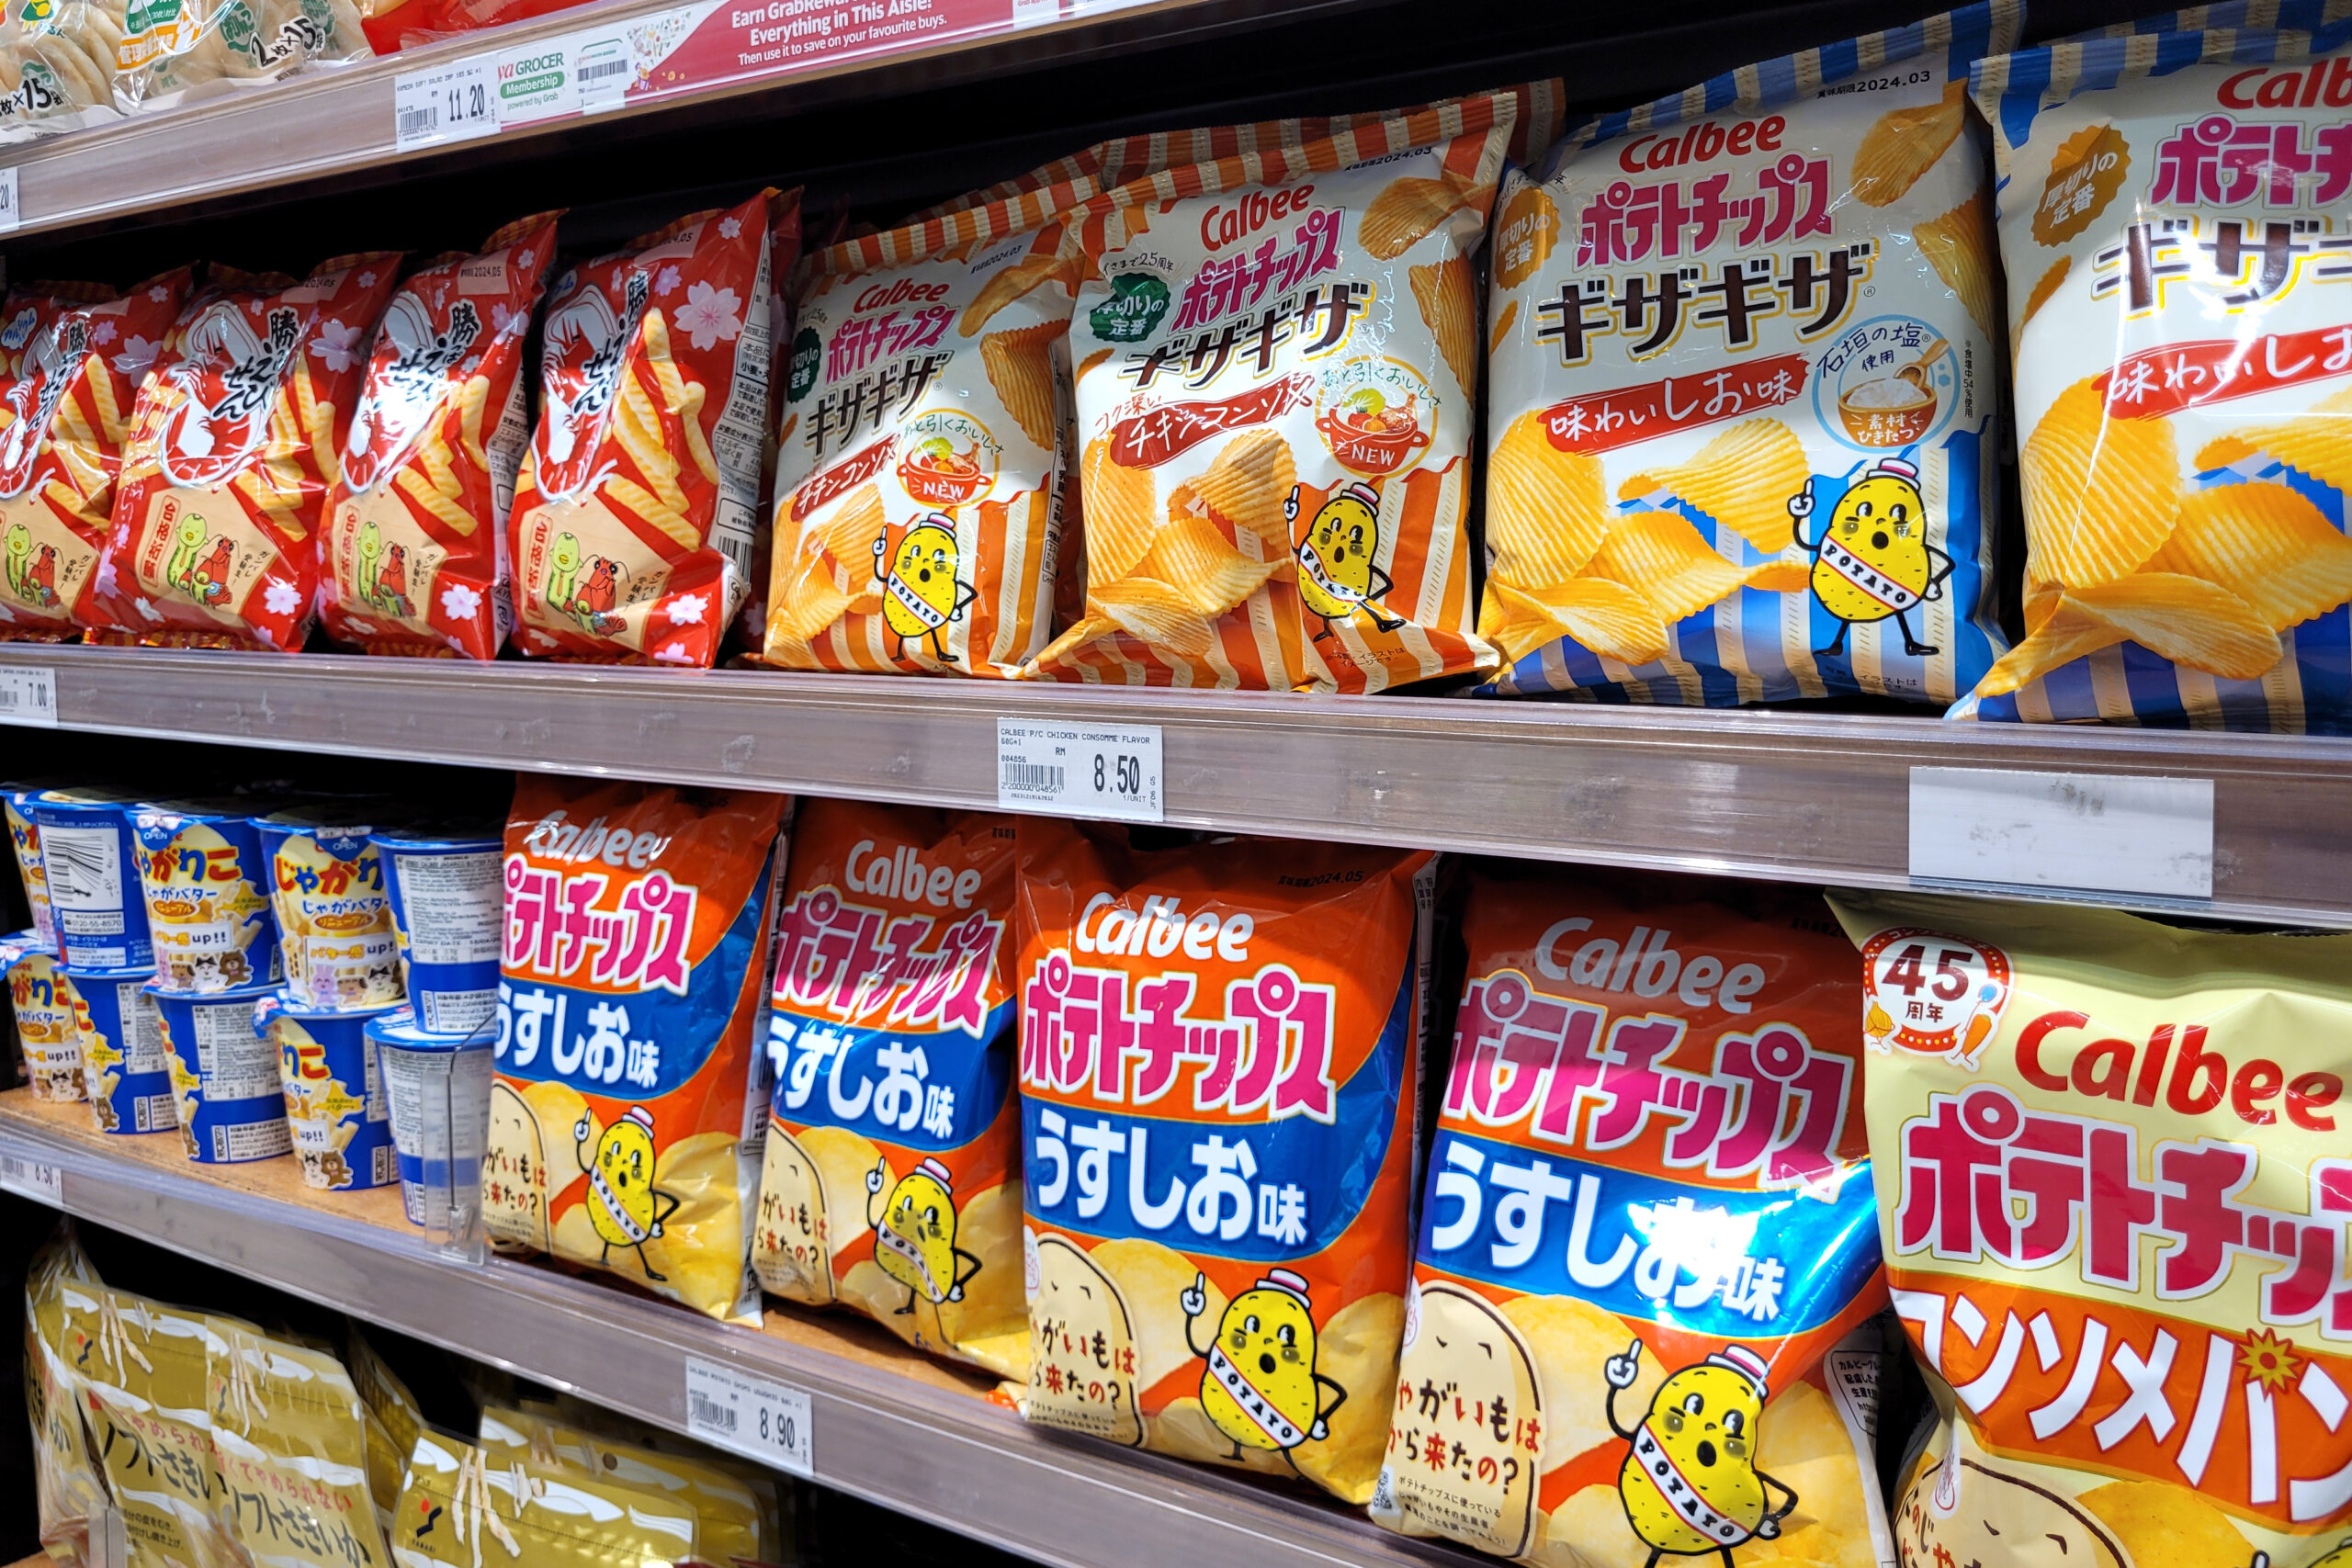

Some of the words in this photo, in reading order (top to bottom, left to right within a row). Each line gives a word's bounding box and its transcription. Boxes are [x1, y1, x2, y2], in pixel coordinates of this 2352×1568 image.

[731, 10, 765, 28] Earn
[738, 52, 763, 67] Then
[763, 50, 781, 62] use
[782, 45, 790, 57] it
[791, 43, 802, 55] to
[803, 40, 827, 52] save
[828, 37, 842, 48] on
[842, 32, 866, 49] your
[868, 18, 917, 39] favourite
[918, 14, 947, 30] buys.
[749, 15, 831, 47] Everything
[833, 12, 849, 28] in
[851, 2, 885, 25] This
[505, 73, 560, 96] Membership
[515, 52, 565, 76] GROCER
[0, 77, 66, 117] 枚×15袋
[448, 83, 485, 122] 11.20
[507, 96, 533, 110] powered
[533, 96, 542, 107] by
[543, 91, 559, 103] Grab
[1618, 116, 1786, 175] Calbee
[1199, 183, 1316, 252] Calbee
[1577, 153, 1833, 268] ポテトチップス
[2048, 183, 2096, 229] 定番
[1170, 208, 1343, 333] ポテトチップス
[1504, 239, 1533, 274] 定番
[853, 277, 950, 314] Calbee
[1537, 243, 1871, 361] ギザギザ
[826, 304, 961, 386] ポテトチップス
[1109, 317, 1148, 337] 定番
[1122, 282, 1373, 389] ギザギザ
[1816, 322, 1924, 380] 石垣の塩
[1861, 350, 1894, 372] 使用
[806, 350, 956, 454] ギザギザ
[1549, 370, 1800, 444] 味わいしお味
[1868, 412, 1906, 431] 素材
[800, 434, 901, 513] チキンコンソメ
[1351, 446, 1397, 467] NEW
[922, 479, 967, 499] NEW
[888, 577, 940, 624] POTATO
[1823, 544, 1908, 604] POTATO
[1001, 728, 1026, 738] CALBEE
[1046, 731, 1078, 740] CHICKEN
[1081, 733, 1118, 742] CONSOMME
[1122, 736, 1150, 744] FLAVOR
[1055, 747, 1066, 756] RM
[1093, 753, 1141, 795] 8.50
[143, 830, 168, 840] OPEN
[844, 839, 981, 909] Calbee
[191, 931, 227, 946] up!!
[1074, 891, 1255, 963] Calbee
[773, 887, 1001, 1034] ポテトチップス
[1533, 917, 1767, 1014] Calbee
[1881, 943, 1973, 1002] 45
[1023, 953, 1334, 1121] ポテトチップス
[1905, 1000, 1944, 1023] 周年
[767, 1016, 956, 1139] うすしお味
[1445, 974, 1851, 1197] ポテトチップス
[2015, 1010, 2344, 1133] Calbee
[1035, 1108, 1306, 1247] うすしお味
[1431, 1140, 1786, 1323] うすしお味
[1213, 1355, 1293, 1439] POTATO
[760, 1405, 796, 1450] 8.90
[1639, 1438, 1736, 1537] POTATO
